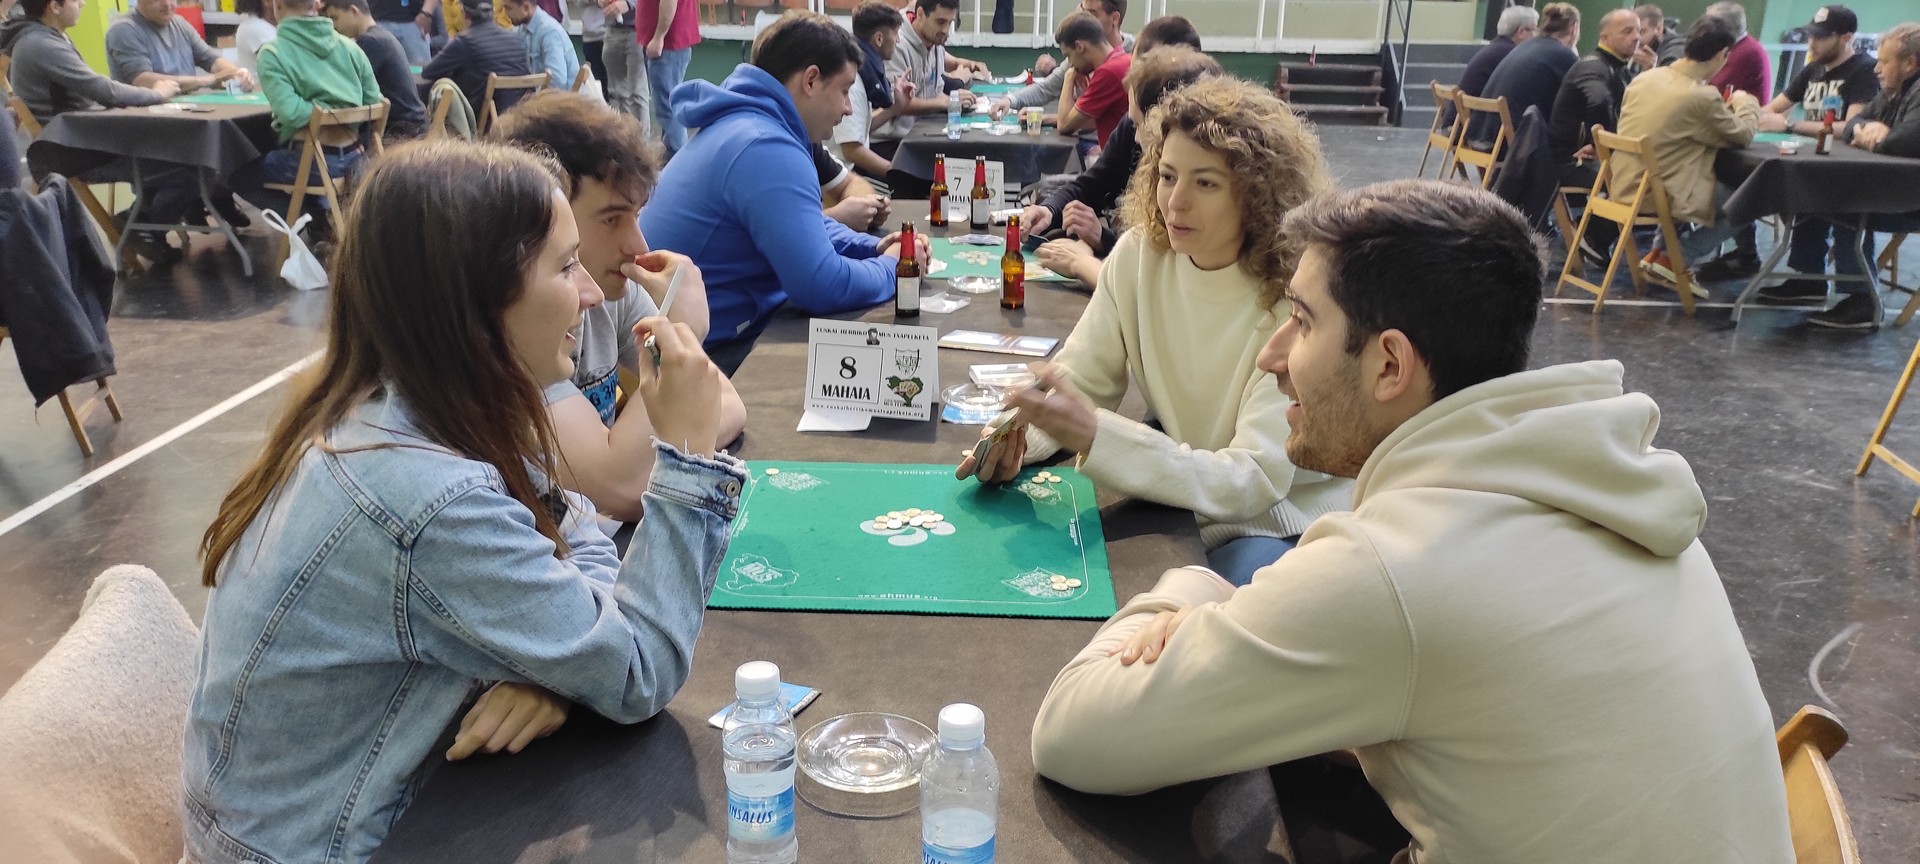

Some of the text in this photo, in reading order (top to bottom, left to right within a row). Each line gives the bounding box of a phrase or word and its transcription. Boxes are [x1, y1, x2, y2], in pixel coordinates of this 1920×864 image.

[953, 177, 962, 191] 7
[839, 356, 857, 379] 8
[821, 384, 871, 400] MAHAIA
[729, 803, 774, 824] INSALUS
